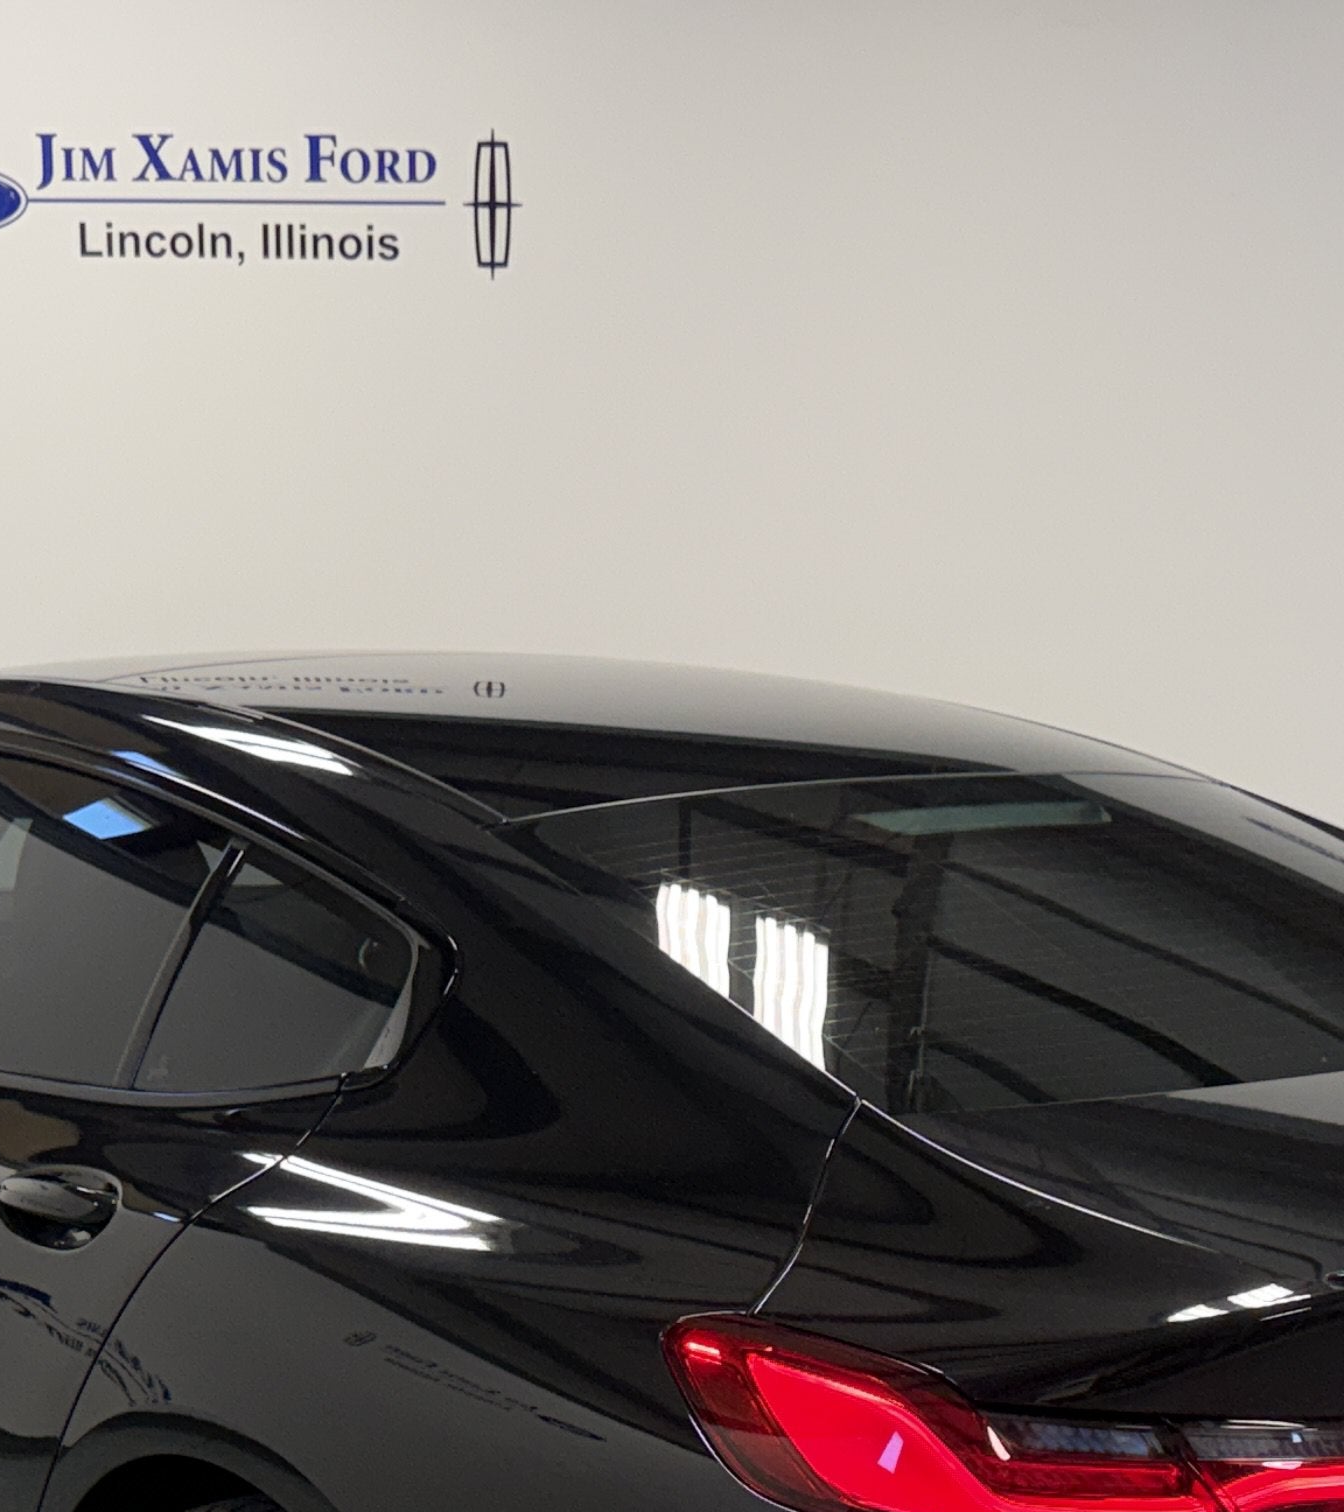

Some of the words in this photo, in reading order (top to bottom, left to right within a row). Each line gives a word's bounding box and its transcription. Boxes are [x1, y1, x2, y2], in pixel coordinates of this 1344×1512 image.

[303, 133, 438, 184] FORD
[79, 221, 246, 265] Lincoln,
[261, 222, 400, 261] Illinois
